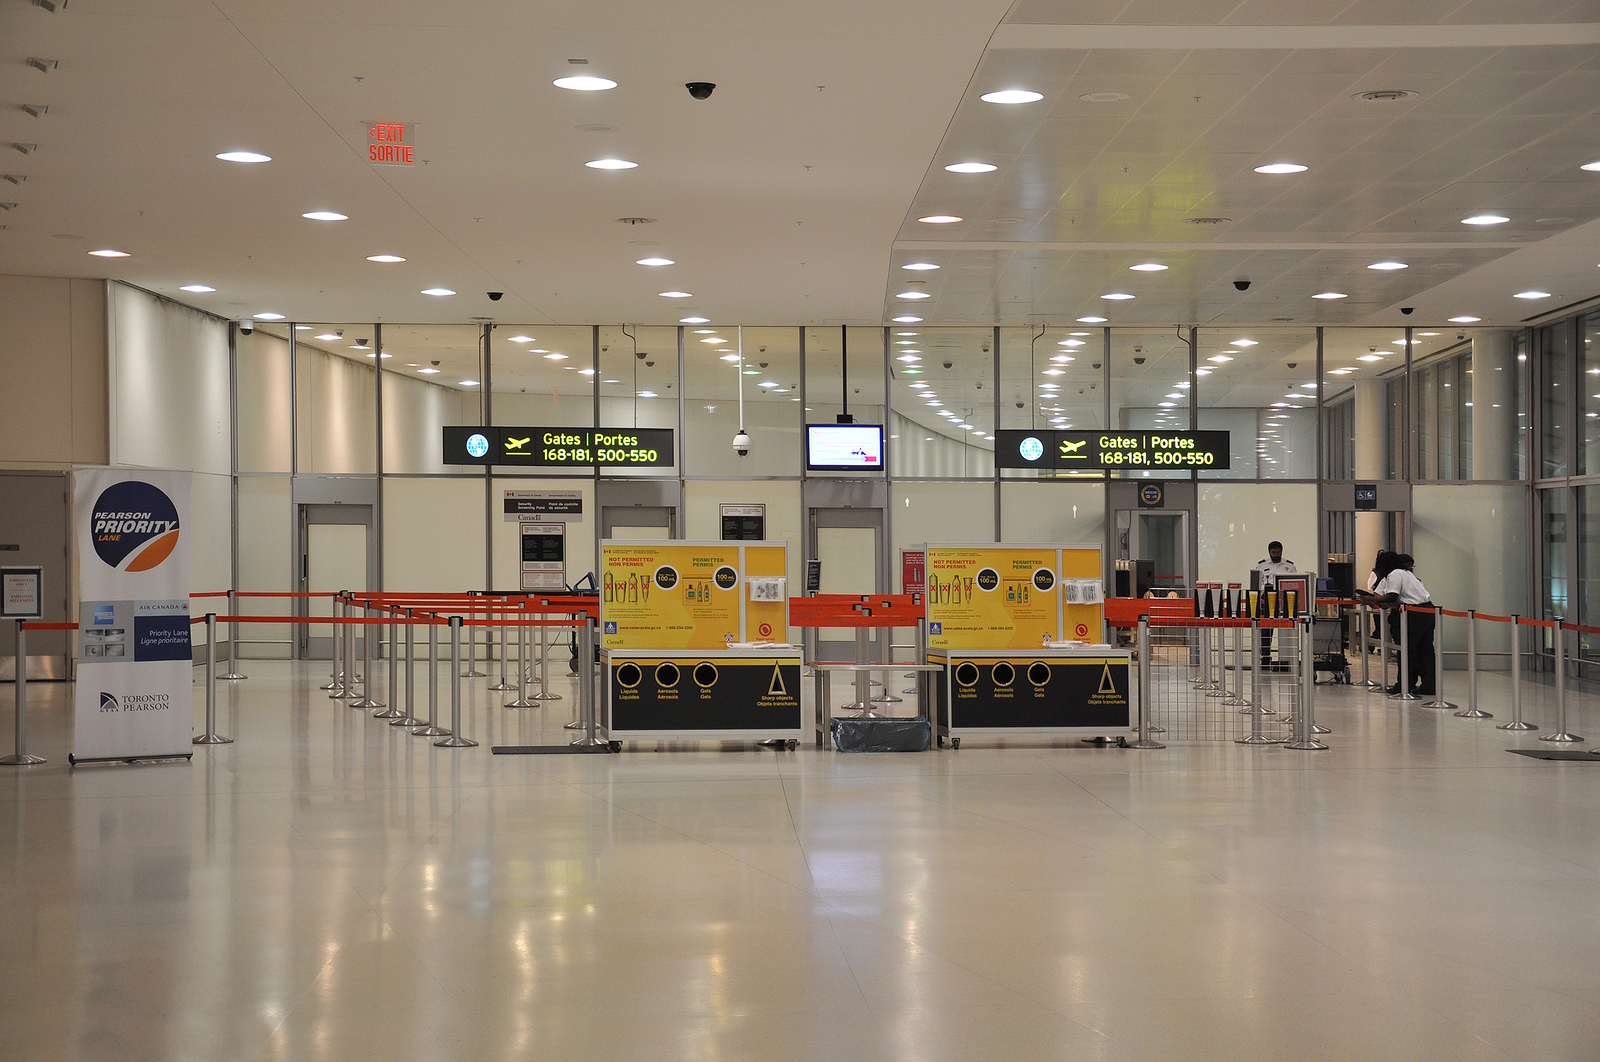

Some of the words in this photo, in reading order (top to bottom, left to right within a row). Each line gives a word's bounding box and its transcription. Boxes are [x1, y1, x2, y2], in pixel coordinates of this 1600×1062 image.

[376, 124, 404, 143] EXIT
[369, 144, 413, 163] SORTIE
[543, 433, 581, 446] Gates
[594, 433, 638, 446] Portes
[1099, 436, 1138, 449] Gates
[1151, 436, 1195, 449] Portes
[543, 449, 594, 463] 168-181,
[597, 450, 657, 462] 500-550
[1099, 452, 1150, 465] 168-181,
[1154, 452, 1214, 465] 500-550
[95, 521, 177, 533] PRIORITY
[140, 638, 157, 646] Ligne
[158, 637, 188, 645] prioritaire
[122, 694, 169, 703] TORONTO
[123, 703, 169, 711] PEARSON
